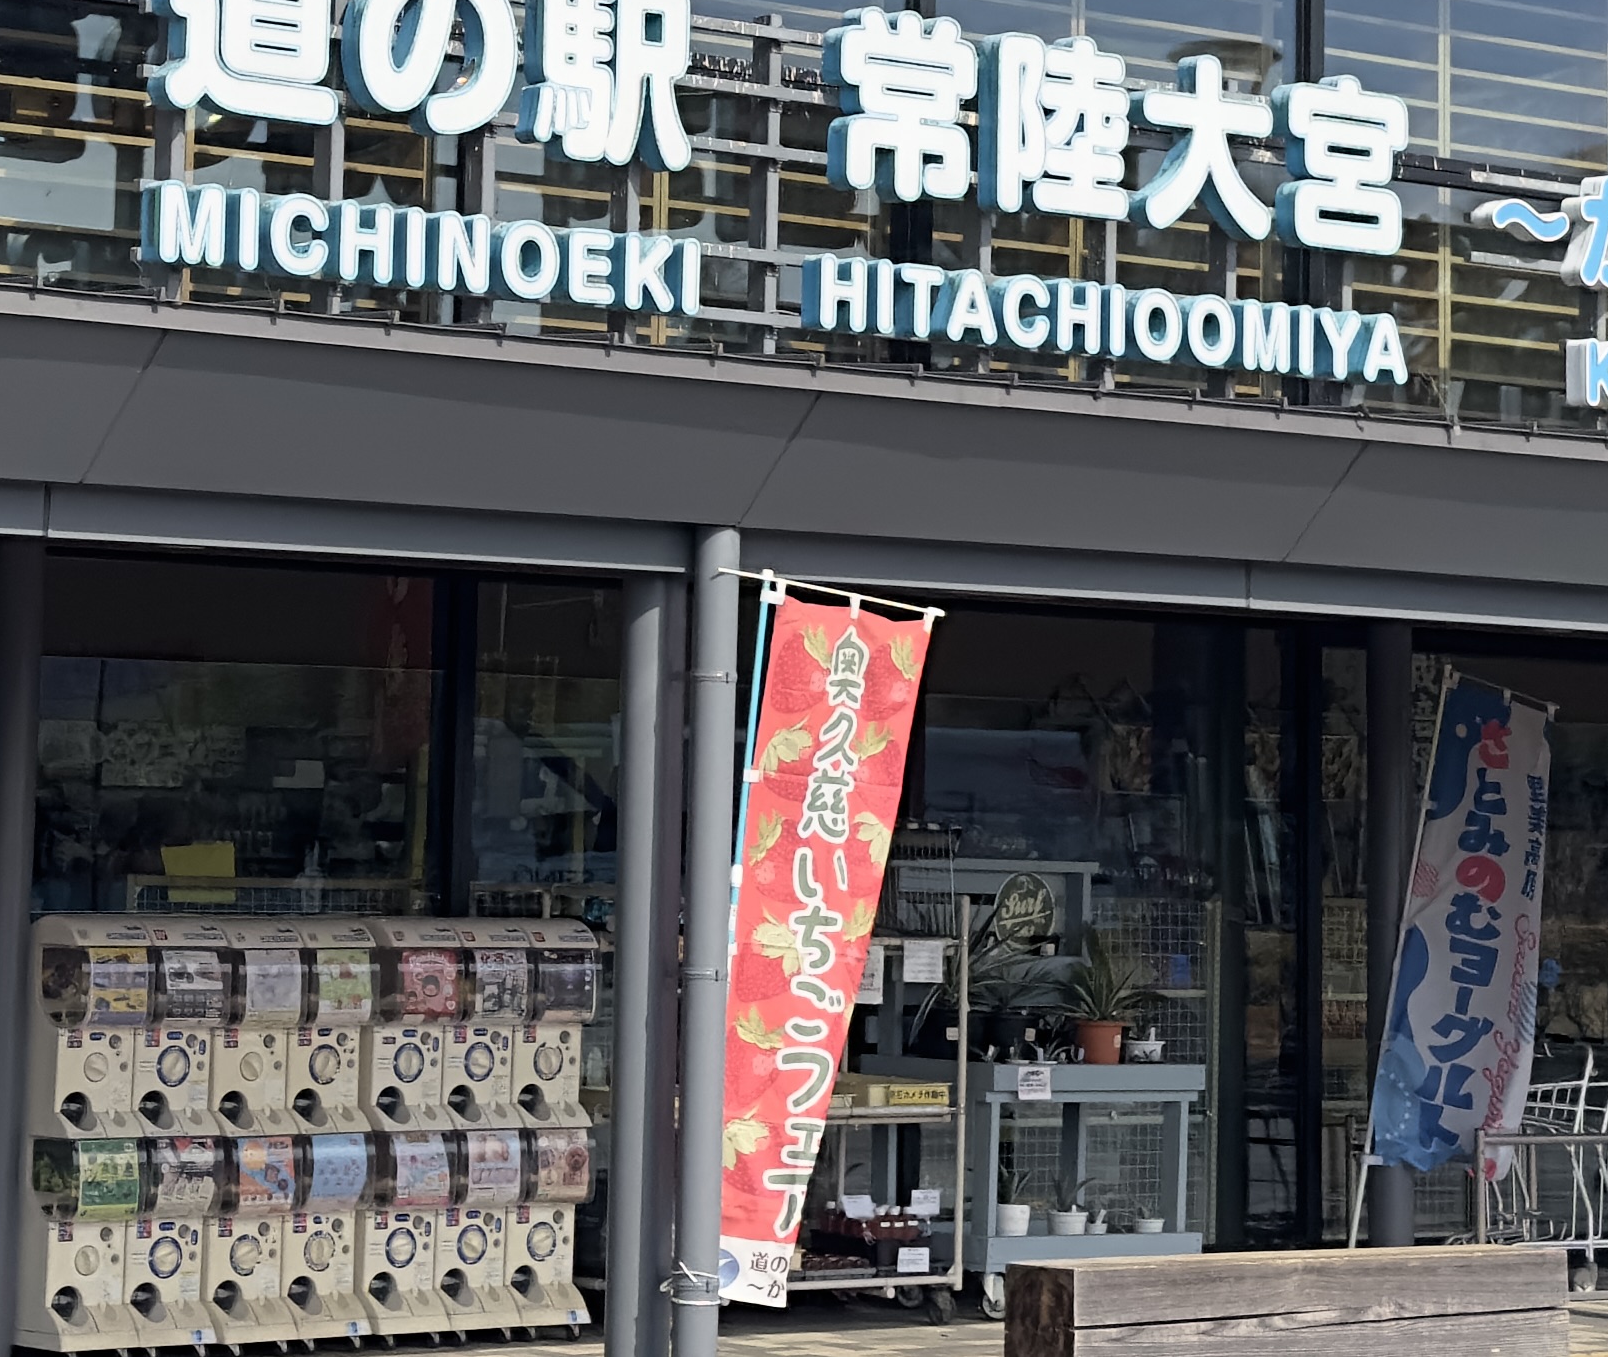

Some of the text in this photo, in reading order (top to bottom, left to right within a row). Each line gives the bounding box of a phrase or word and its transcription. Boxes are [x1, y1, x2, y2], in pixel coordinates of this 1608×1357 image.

[832, 6, 1409, 255] 常陸大宮
[153, 179, 1409, 385] MICHINOEKI HITACHIOOMIYA
[762, 627, 868, 1238] 奥久慈いちごフェア
[1001, 888, 1047, 919] Surf
